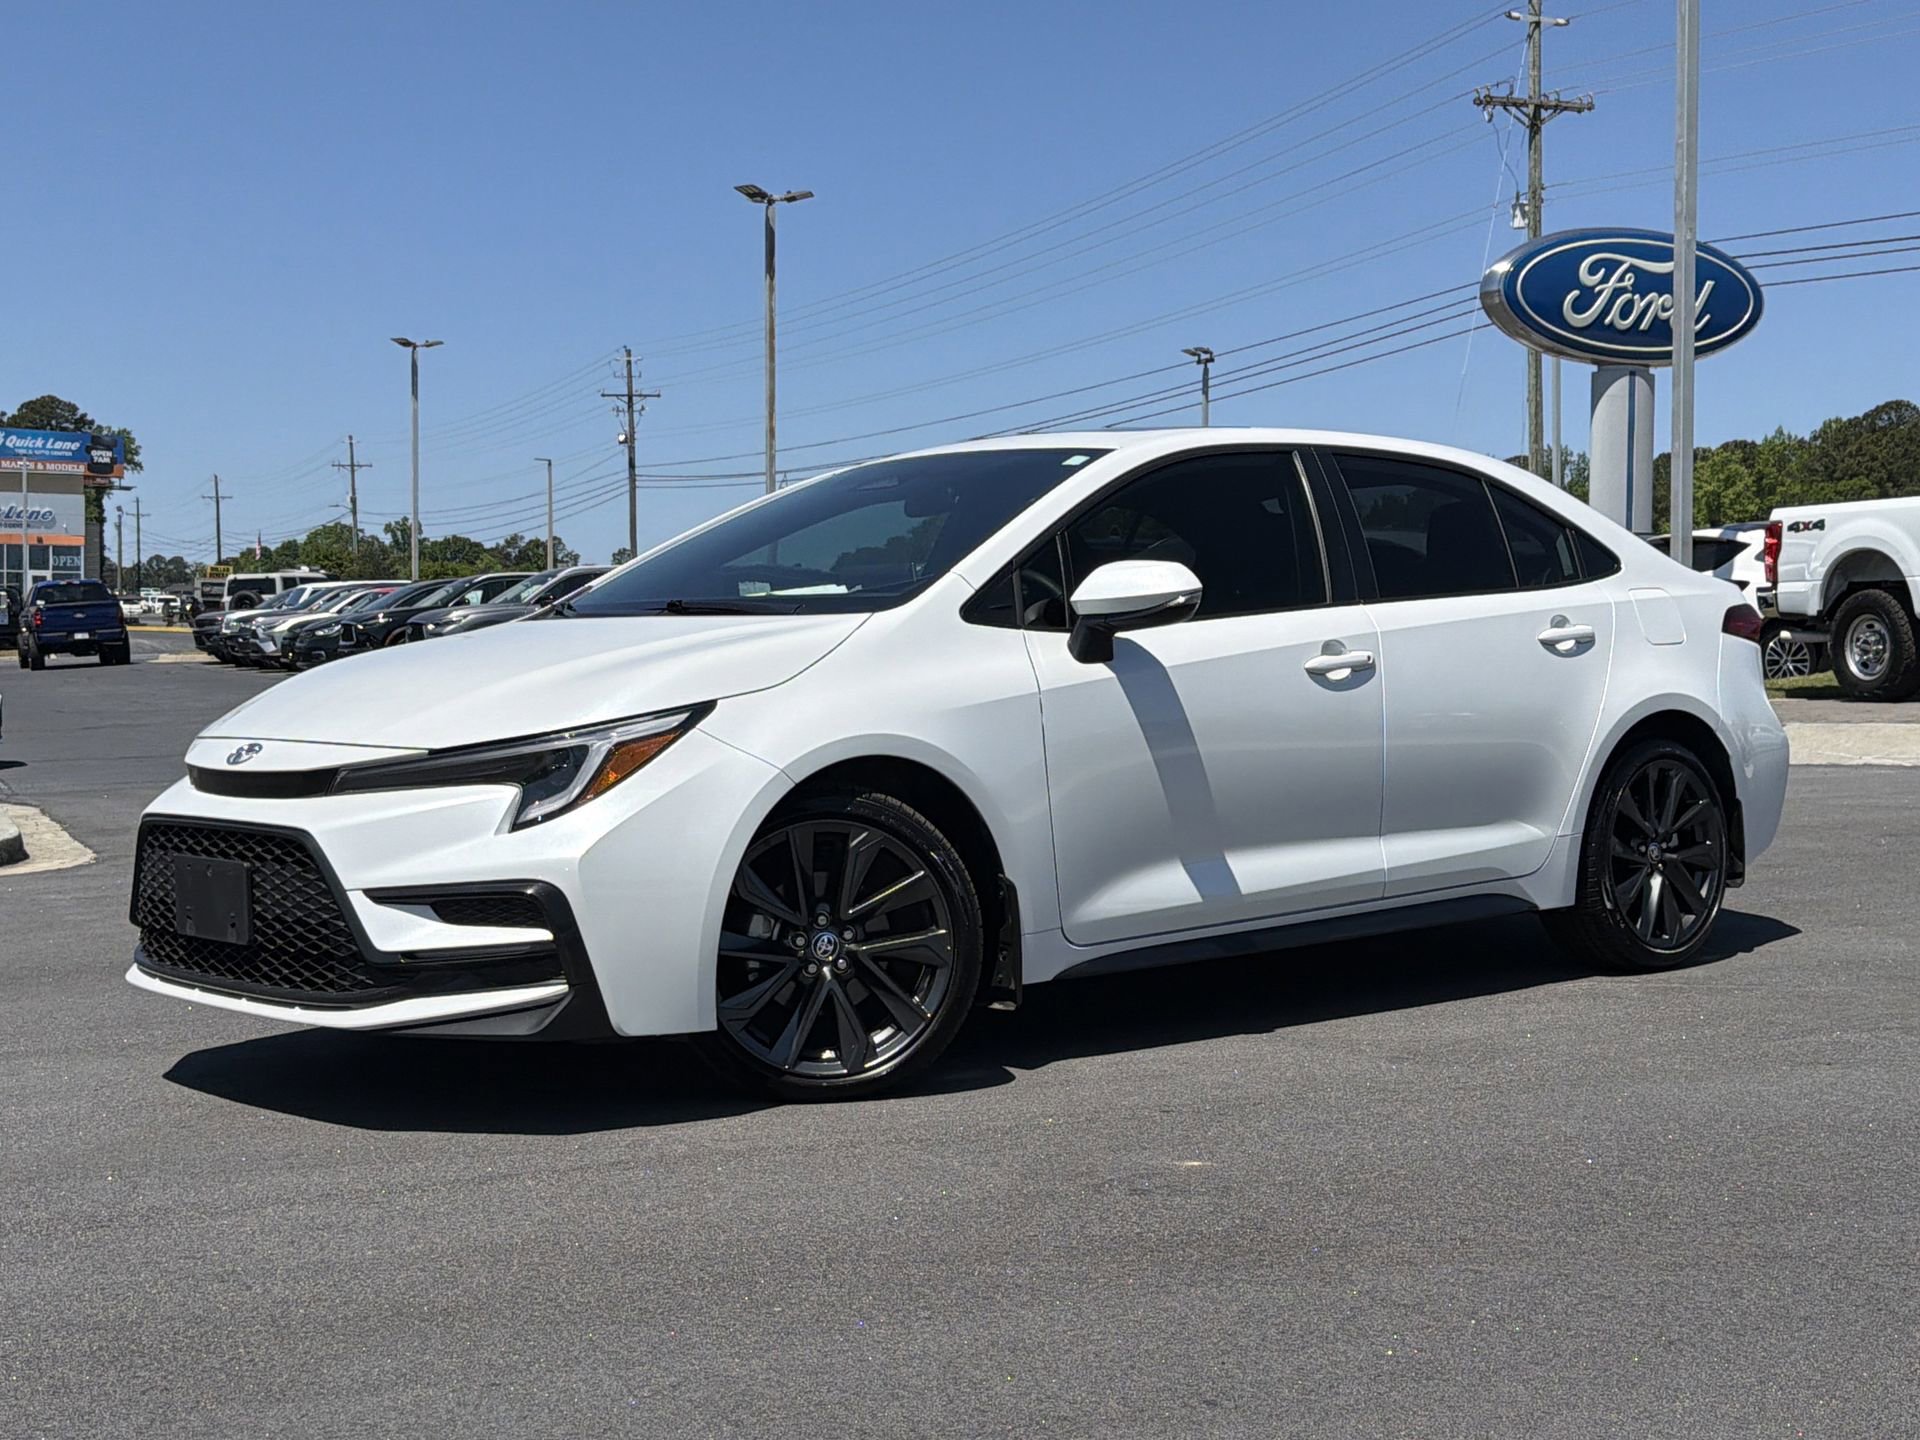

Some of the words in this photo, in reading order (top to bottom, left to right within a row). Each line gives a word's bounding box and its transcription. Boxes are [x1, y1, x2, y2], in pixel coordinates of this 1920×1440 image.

[1563, 252, 1715, 331] Ford
[5, 435, 45, 449] Quick
[46, 438, 80, 451] Lane
[46, 463, 85, 472] MODELS
[52, 556, 80, 566] OPEN
